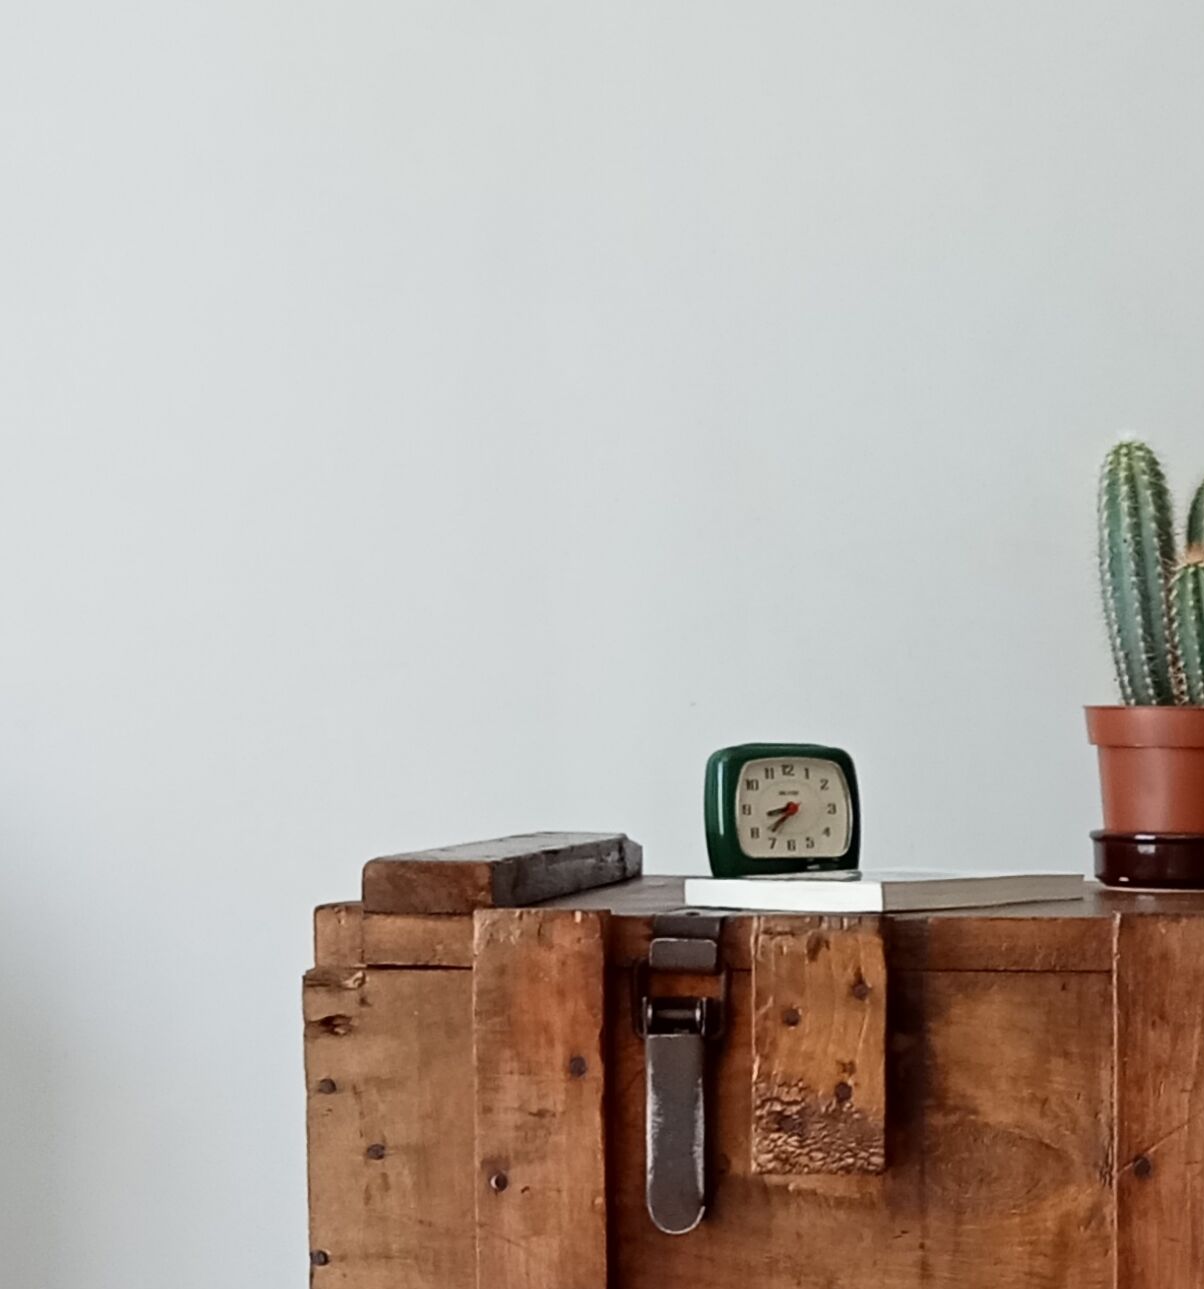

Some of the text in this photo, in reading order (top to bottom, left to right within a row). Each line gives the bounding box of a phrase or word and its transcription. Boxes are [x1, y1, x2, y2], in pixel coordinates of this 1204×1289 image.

[764, 768, 775, 780] 11
[781, 764, 795, 777] 12
[803, 767, 810, 780] 1
[745, 779, 760, 791] 10
[819, 779, 829, 791] 2
[741, 803, 752, 816] 9
[827, 803, 837, 815] 3
[750, 827, 760, 839] 8
[822, 826, 831, 838] 4
[767, 837, 777, 850] 7
[786, 839, 797, 852] 6
[805, 837, 815, 849] 5
